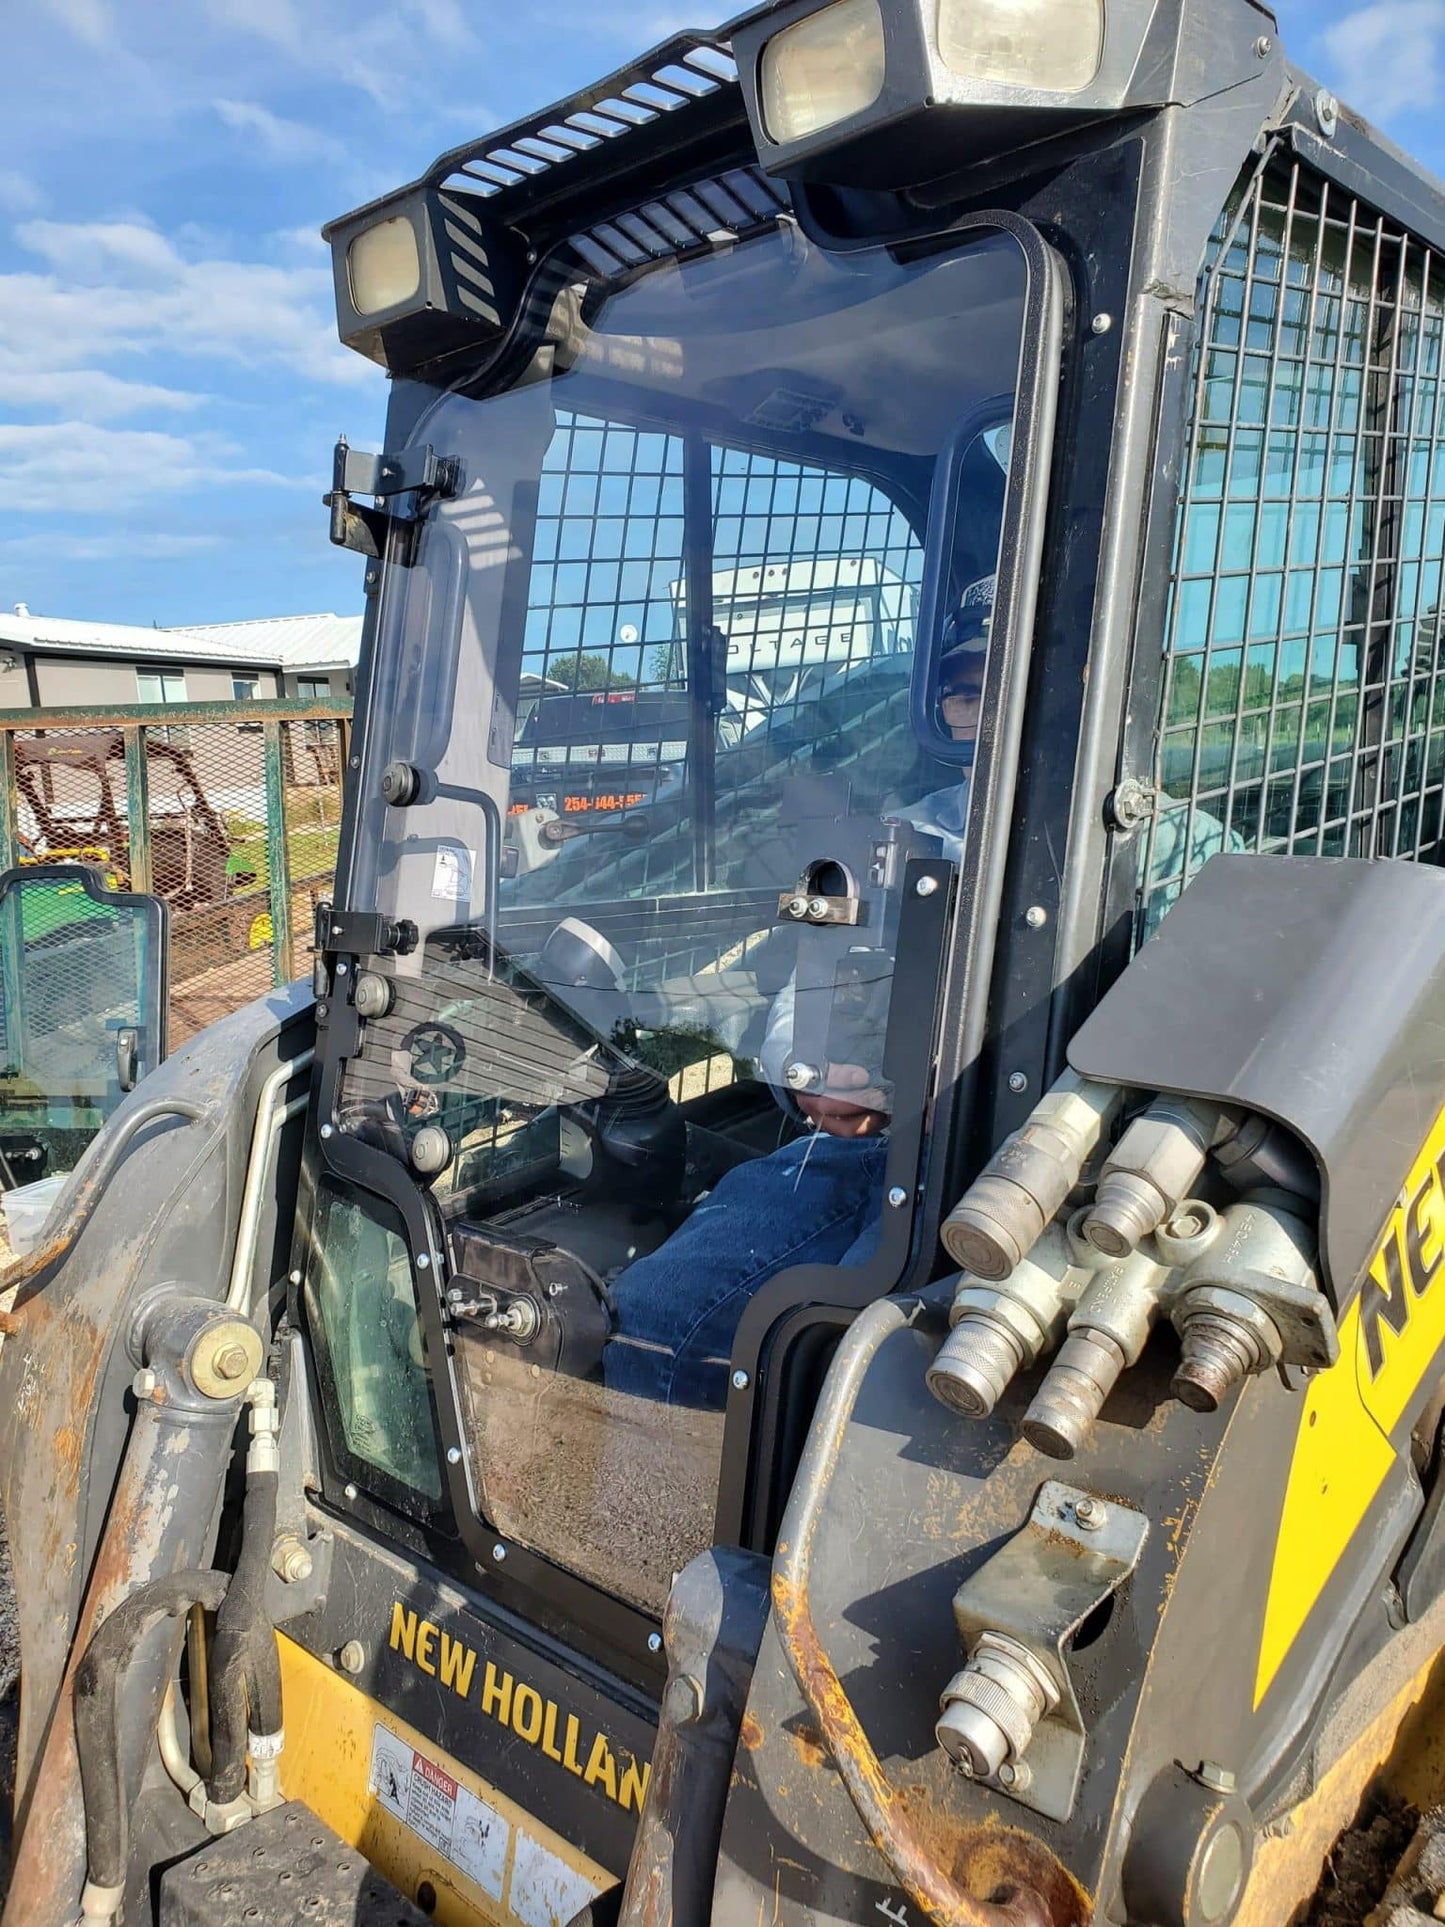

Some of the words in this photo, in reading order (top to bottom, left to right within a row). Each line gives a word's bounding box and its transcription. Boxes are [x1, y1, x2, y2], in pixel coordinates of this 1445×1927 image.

[727, 633, 851, 655] OLTAGE
[389, 1601, 476, 1699] NEW
[481, 1661, 651, 1815] HOLLAN
[424, 1767, 453, 1796] DANGER
[431, 1787, 452, 1808] HAZARD
